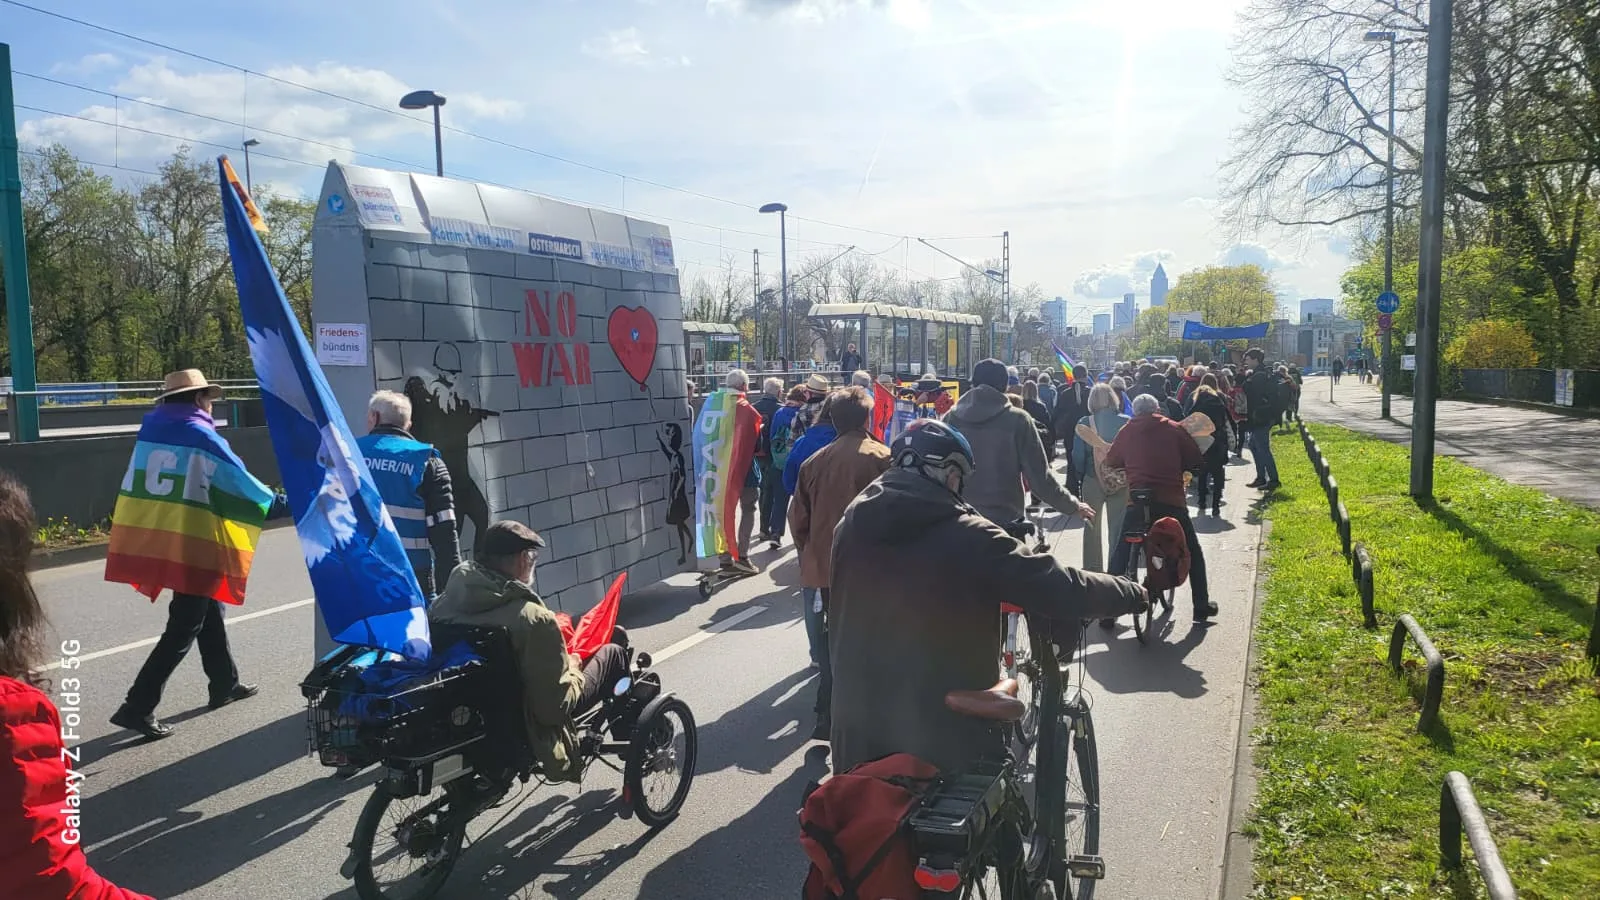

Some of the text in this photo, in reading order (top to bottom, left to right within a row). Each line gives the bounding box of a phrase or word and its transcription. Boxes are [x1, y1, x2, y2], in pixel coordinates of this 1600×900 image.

[530, 238, 581, 257] OSTERMARSCH
[525, 289, 576, 337] NO
[320, 327, 364, 337] Friedens-
[322, 341, 361, 352] bündnis
[511, 342, 592, 388] WAR
[121, 449, 217, 505] CE
